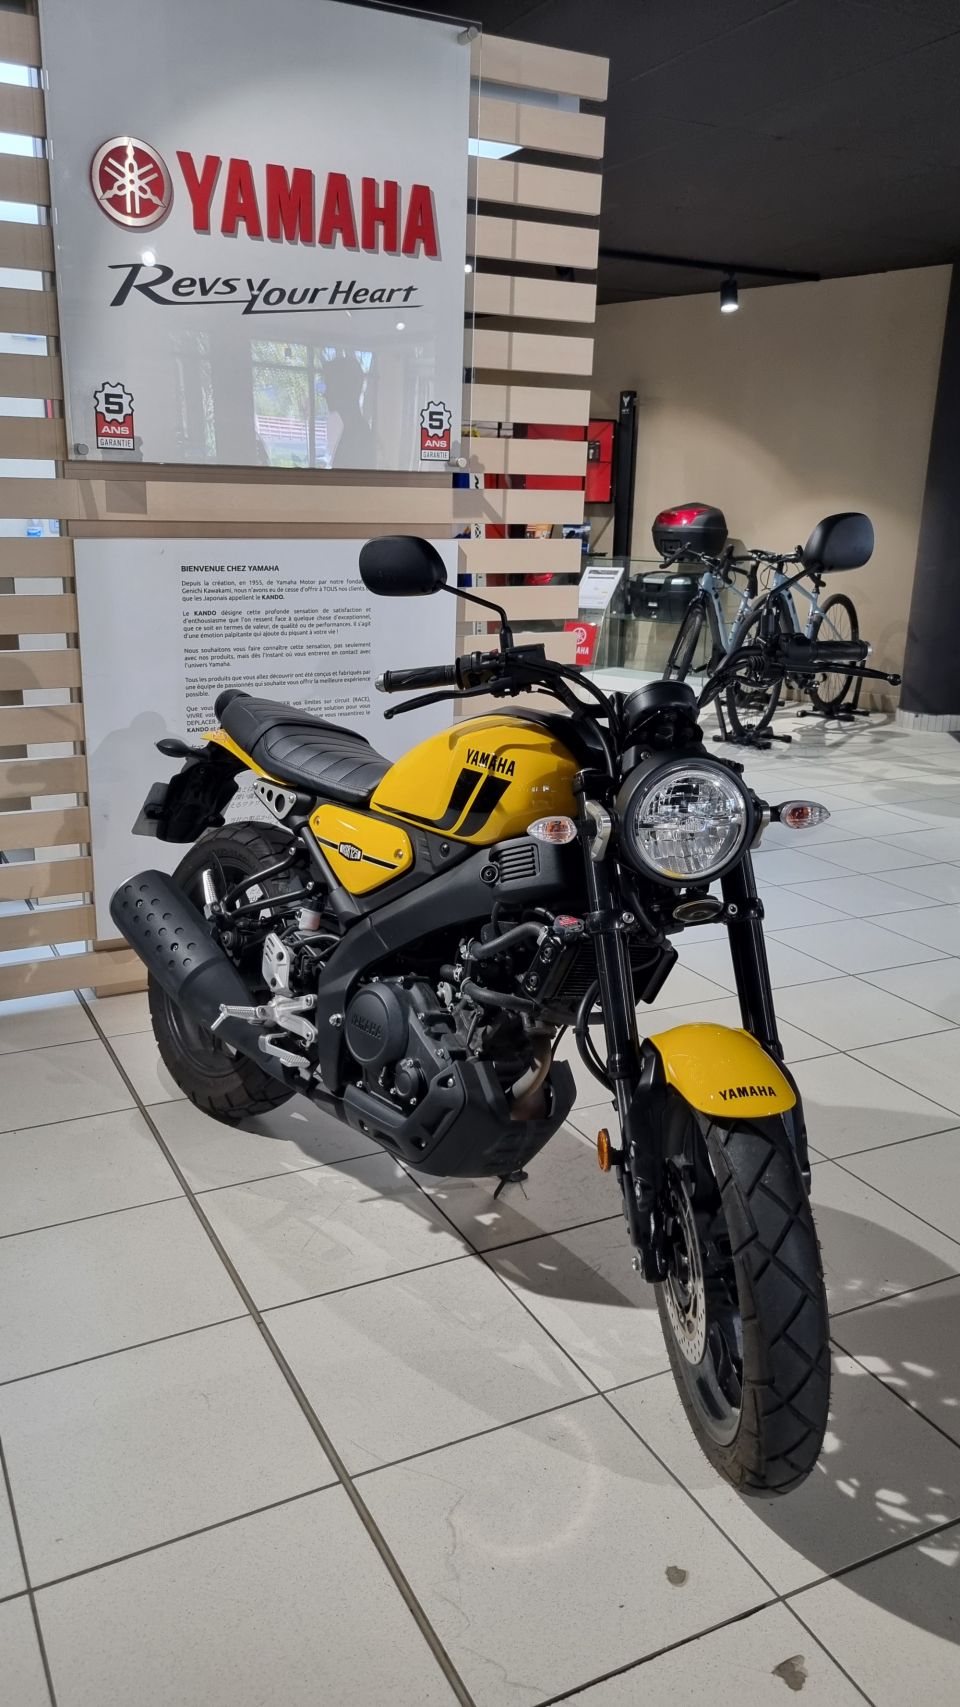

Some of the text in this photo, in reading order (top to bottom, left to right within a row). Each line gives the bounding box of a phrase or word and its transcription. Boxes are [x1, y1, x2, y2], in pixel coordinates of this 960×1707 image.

[176, 150, 439, 258] YAMAHA
[107, 262, 419, 315] Revs Your Heart
[105, 393, 123, 415] 5
[428, 411, 444, 430] 5
[101, 425, 130, 435] ANS
[100, 437, 132, 449] GARANTIE
[424, 439, 447, 448] ANS
[422, 450, 448, 460] GARANTIE
[466, 748, 516, 777] YAMAHA
[718, 1084, 778, 1102] YAMAHA
